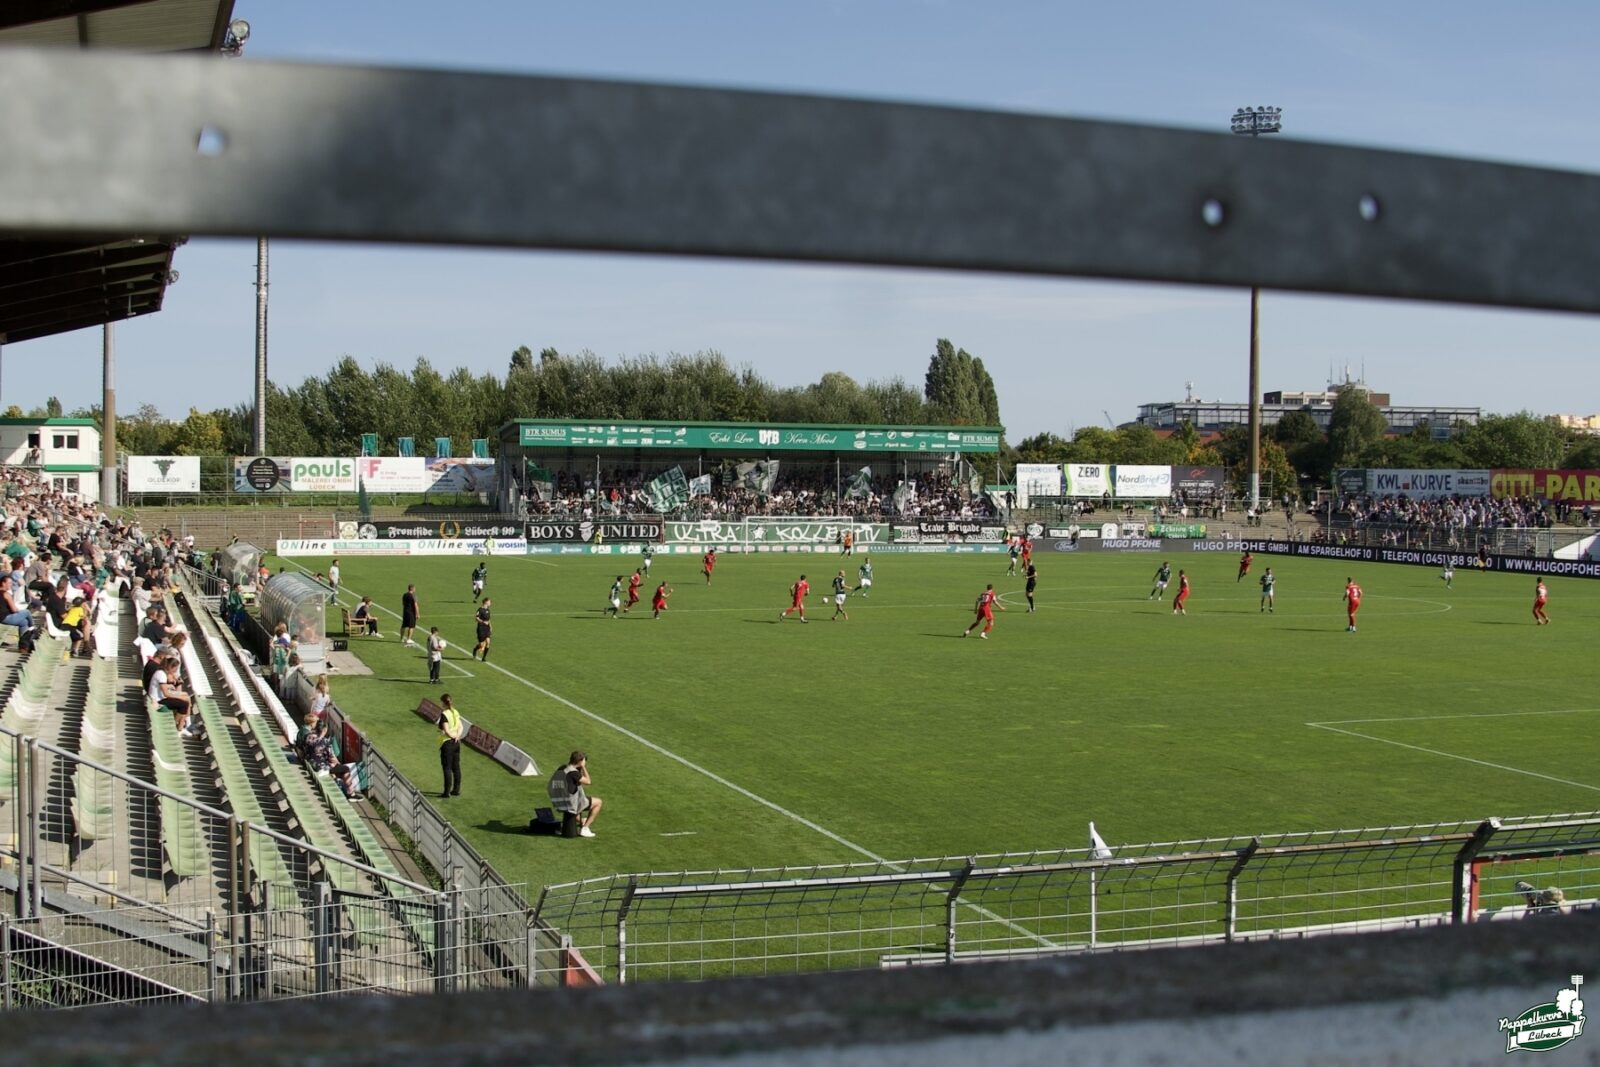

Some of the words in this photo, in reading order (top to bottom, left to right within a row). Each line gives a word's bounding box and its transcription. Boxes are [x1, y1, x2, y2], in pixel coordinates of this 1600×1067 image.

[294, 459, 351, 481] pauls
[1118, 474, 1160, 484] NordBrief
[1377, 474, 1400, 490] KWL
[1411, 474, 1452, 490] KURVE
[502, 526, 515, 536] 99
[530, 525, 574, 539] BOYS
[600, 524, 660, 538] UNITED
[920, 523, 944, 533] Trave
[947, 522, 980, 534] Brigade
[1102, 538, 1129, 548] HUGO
[1131, 539, 1162, 549] PFOHE
[1193, 541, 1224, 551] HUGO
[1227, 541, 1266, 551] PFOHE
[1268, 542, 1289, 552] GMBH
[1297, 545, 1310, 554] AM
[1310, 546, 1362, 558] SPARGELHOF
[1363, 549, 1372, 559] 10
[1382, 550, 1422, 562] TELEFON
[1466, 556, 1493, 568] 900
